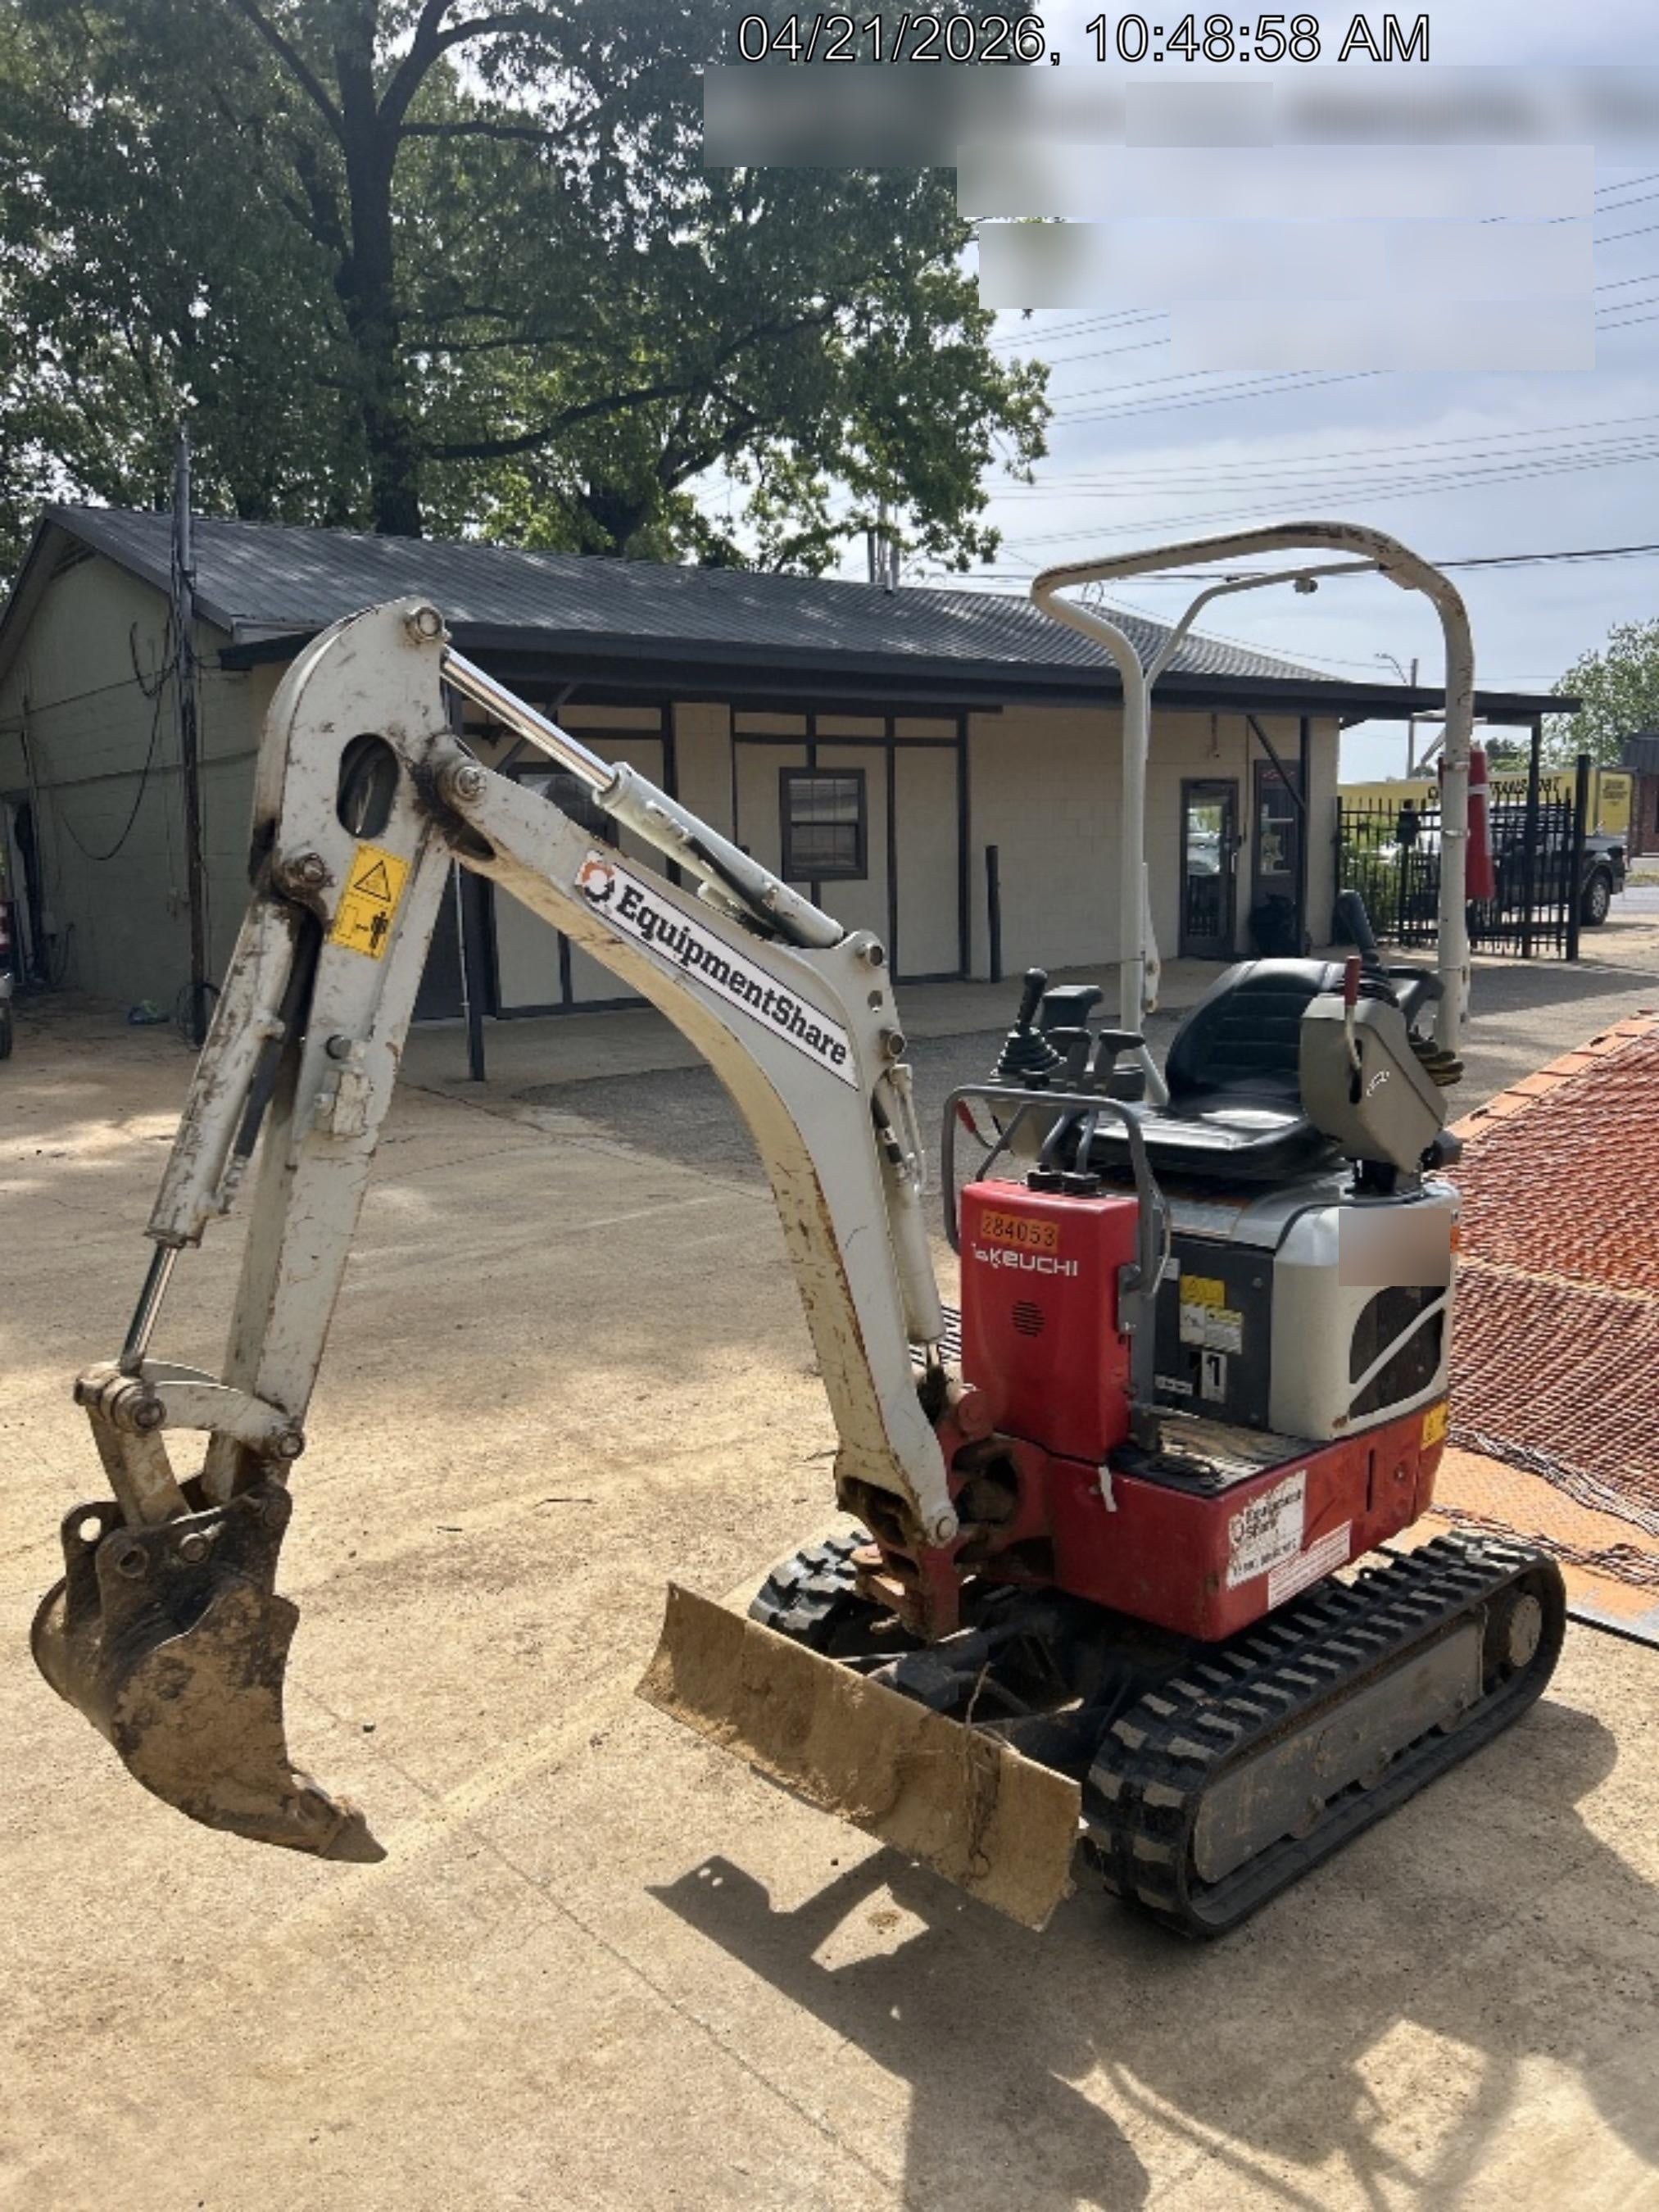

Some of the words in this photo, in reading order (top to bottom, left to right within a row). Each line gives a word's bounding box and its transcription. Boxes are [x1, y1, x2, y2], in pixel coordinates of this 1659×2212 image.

[1489, 777, 1562, 796] TRANSORT
[615, 884, 847, 1065] EquipmentShare
[983, 1216, 1056, 1247] 284053
